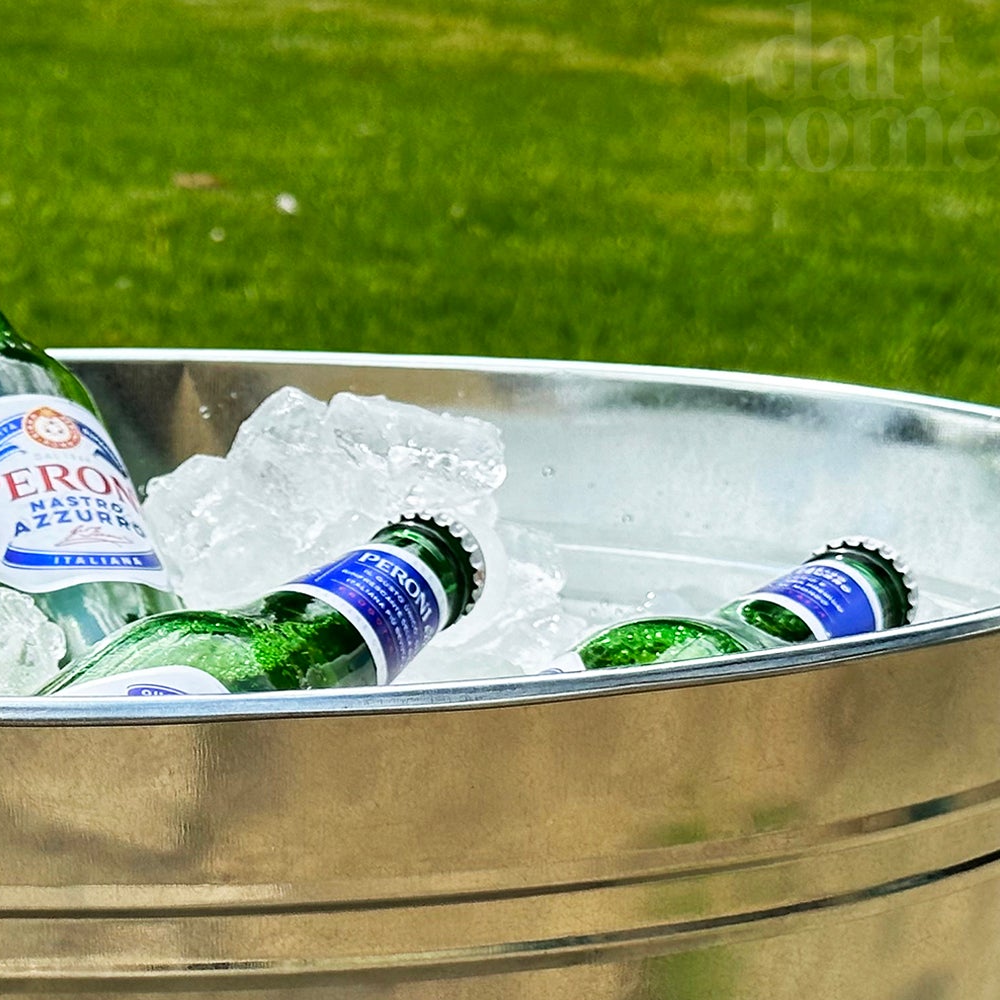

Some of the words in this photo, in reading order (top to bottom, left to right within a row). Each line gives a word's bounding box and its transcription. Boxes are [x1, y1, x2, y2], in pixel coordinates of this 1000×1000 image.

[29, 495, 124, 514] NASTRO
[13, 508, 147, 539] AZZURRO
[53, 555, 144, 567] ITALIANA
[345, 577, 386, 609] ITALIANA
[357, 551, 433, 622] PERONI
[376, 575, 405, 604] GUSTO
